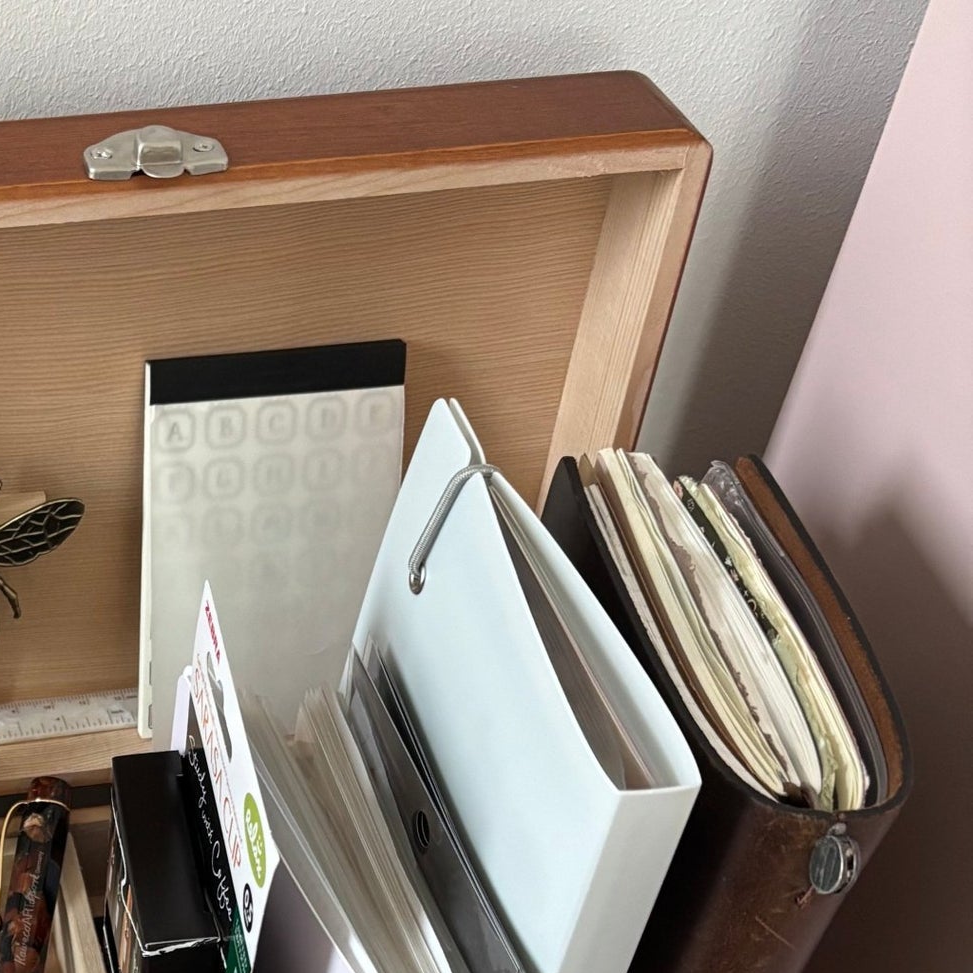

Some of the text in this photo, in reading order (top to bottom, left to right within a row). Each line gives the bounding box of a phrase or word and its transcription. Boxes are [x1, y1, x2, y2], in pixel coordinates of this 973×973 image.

[188, 734, 208, 806] Study
[201, 811, 214, 845] with
[211, 840, 233, 922] Coffee
[223, 797, 243, 870] CLIP
